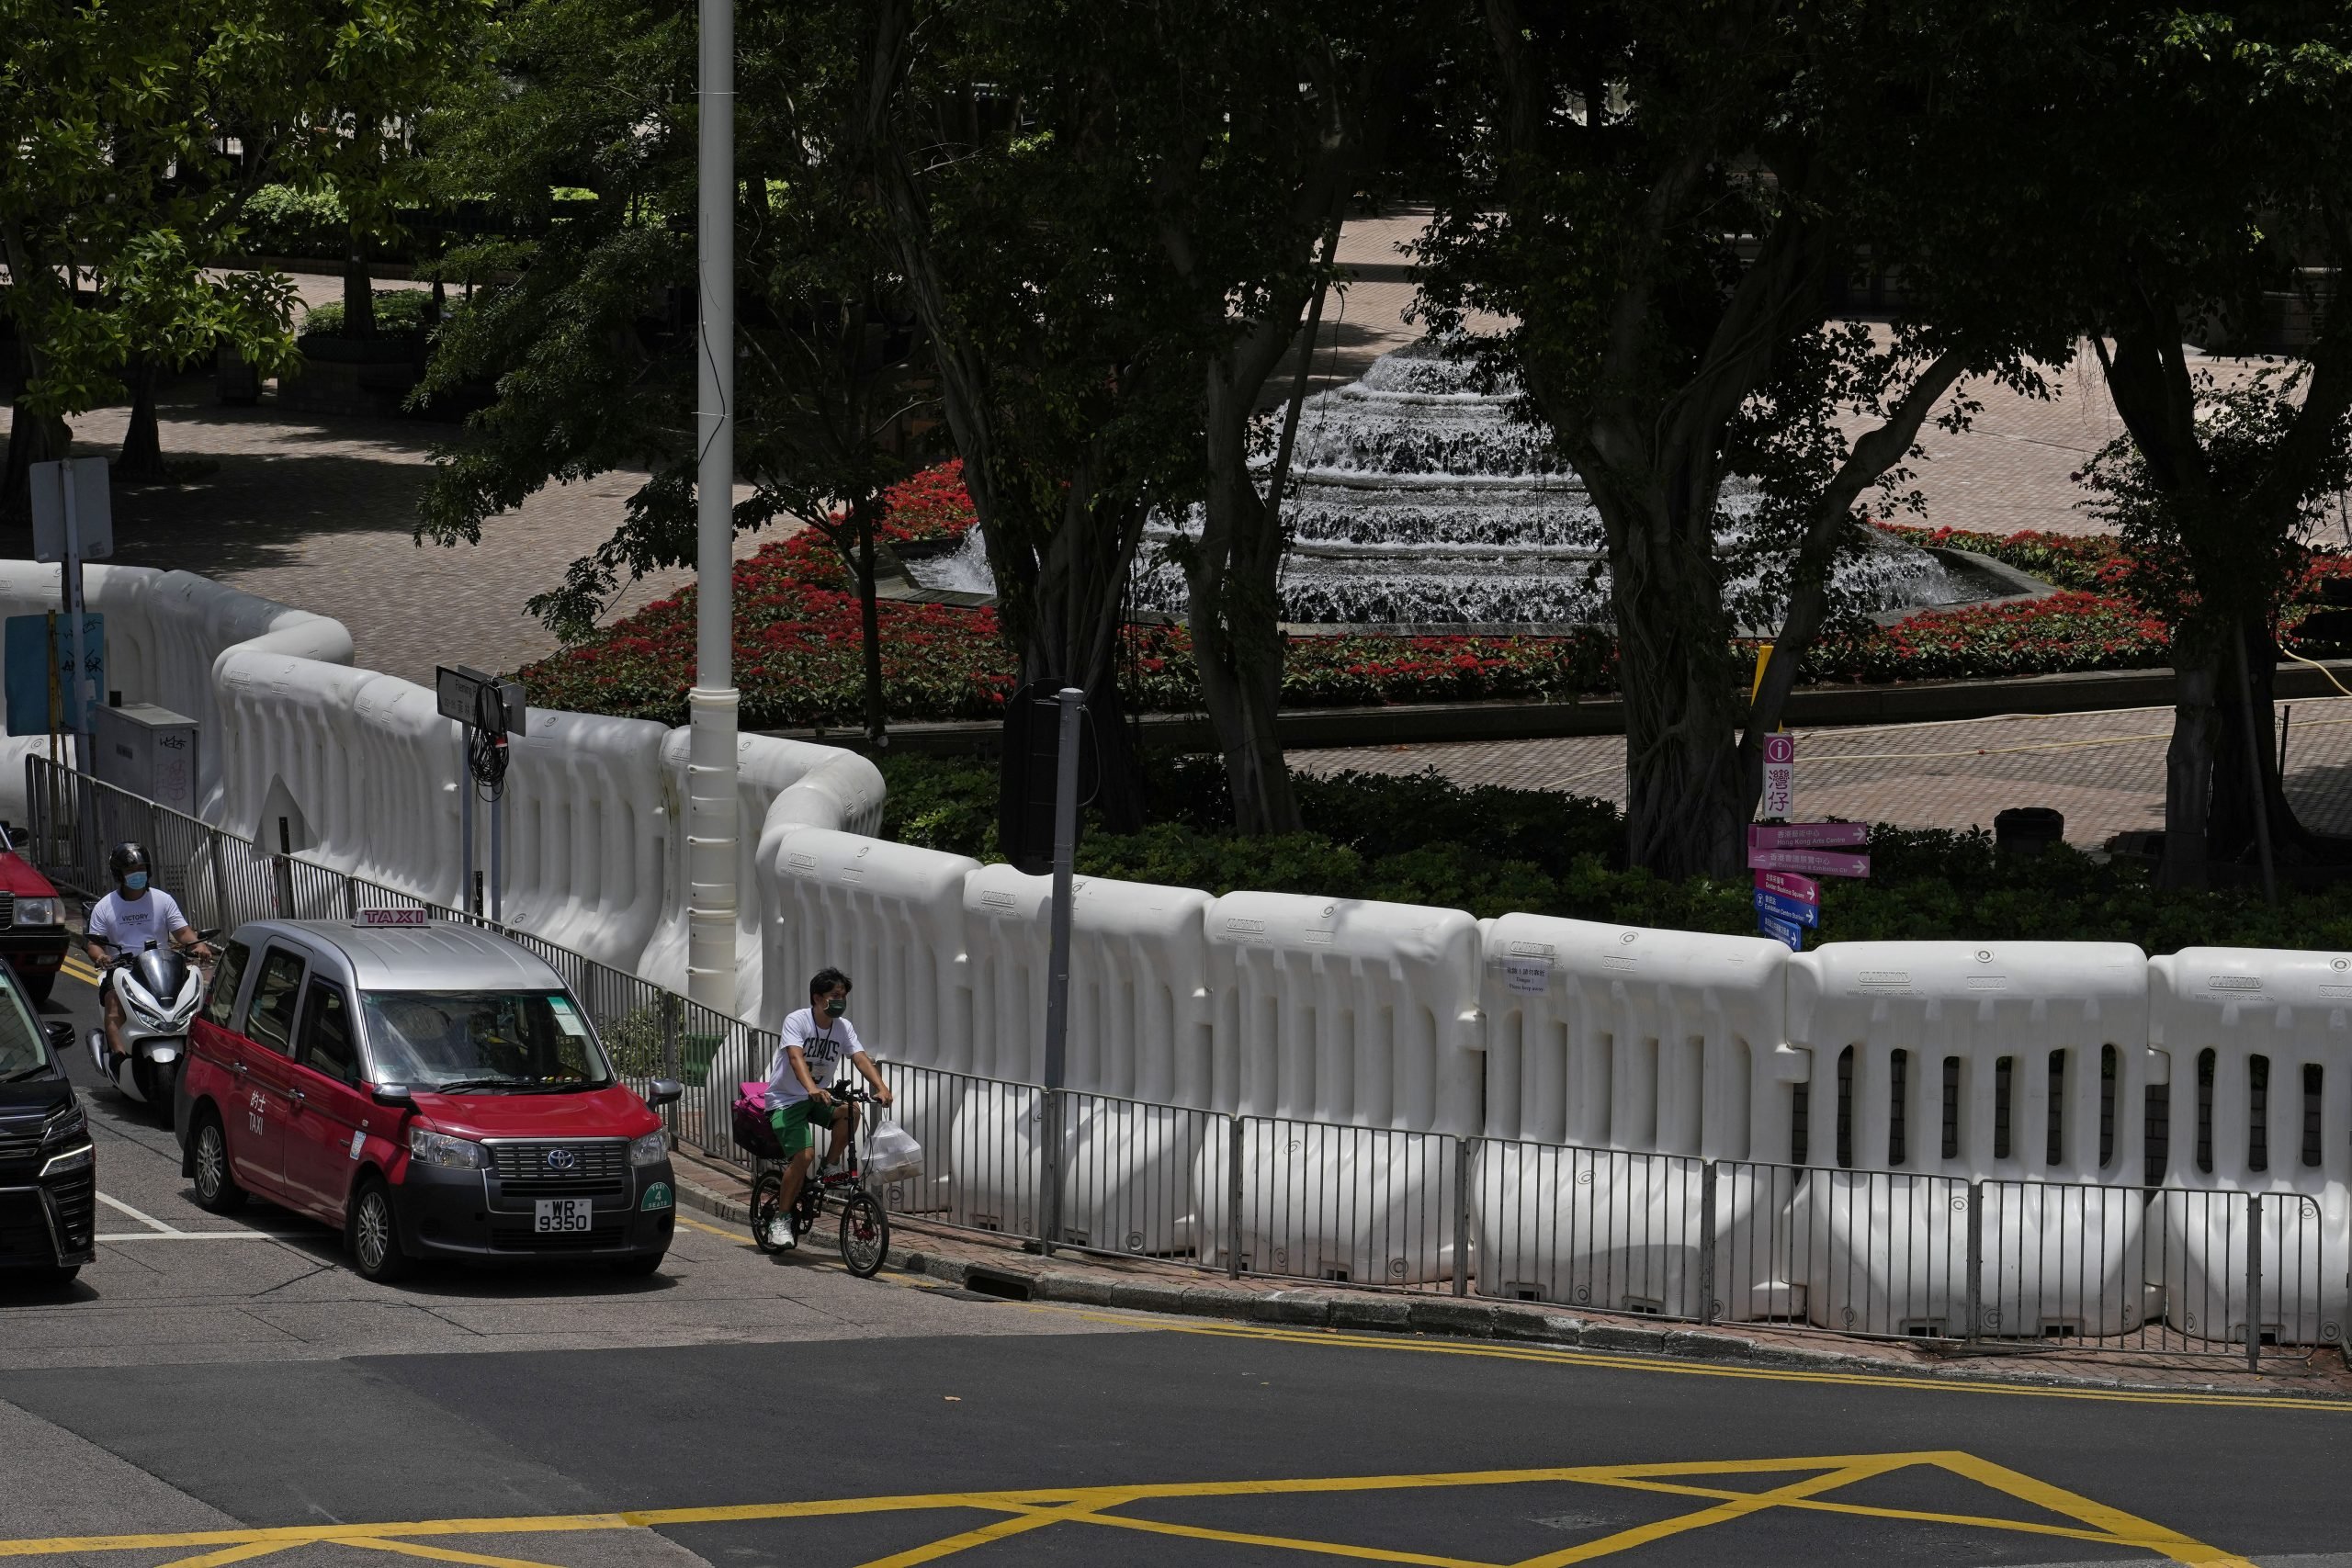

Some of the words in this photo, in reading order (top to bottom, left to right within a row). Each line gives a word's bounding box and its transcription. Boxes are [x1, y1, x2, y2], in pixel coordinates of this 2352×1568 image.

[455, 679, 472, 698] Fleming
[1768, 769, 1791, 812] 灣仔
[121, 913, 149, 921] VICTORY
[364, 909, 424, 924] TAXI
[802, 1036, 840, 1062] CELTICS
[249, 1089, 266, 1113] 的士
[248, 1111, 264, 1136] TAXI
[651, 1183, 666, 1191] TAXI
[654, 1190, 662, 1201] 4
[551, 1200, 575, 1216] WR
[647, 1200, 668, 1209] SEATS
[538, 1214, 588, 1231] 9350
